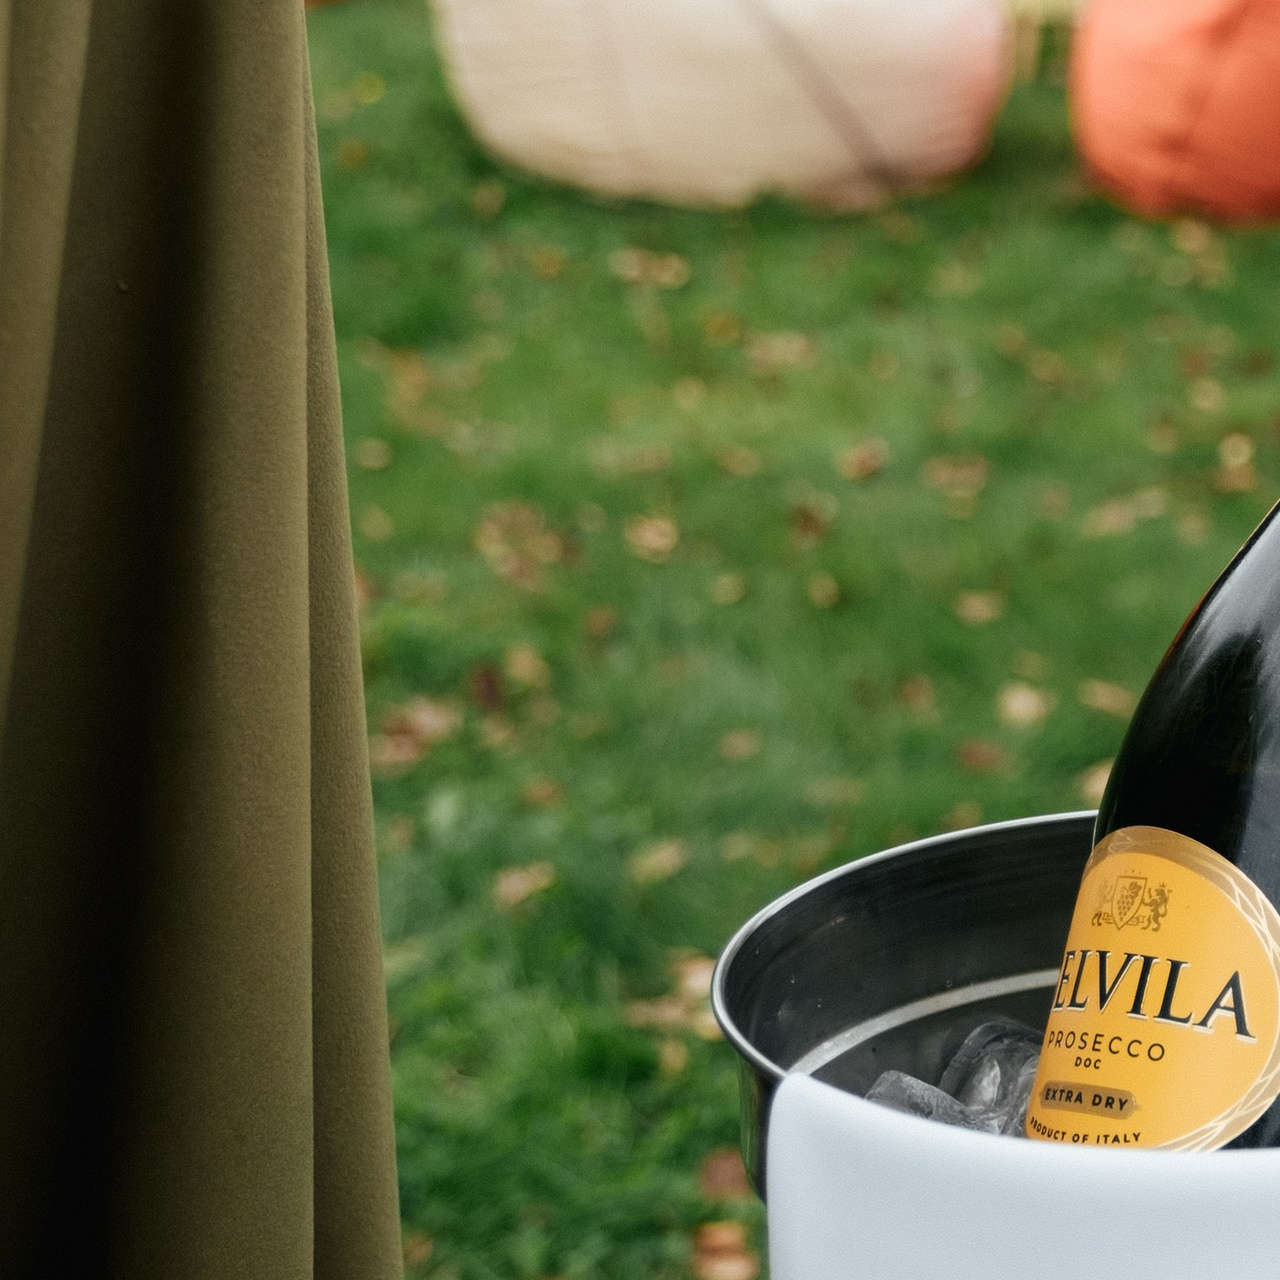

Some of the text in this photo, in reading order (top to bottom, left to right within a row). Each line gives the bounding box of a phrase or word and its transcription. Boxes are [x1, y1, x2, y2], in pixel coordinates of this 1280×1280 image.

[1046, 1030, 1166, 1062] PROSECCO
[1074, 1056, 1102, 1070] DOC
[1044, 1088, 1129, 1111] EXTRA DRY
[1030, 1116, 1141, 1144] PRODUCT OF ITALY
